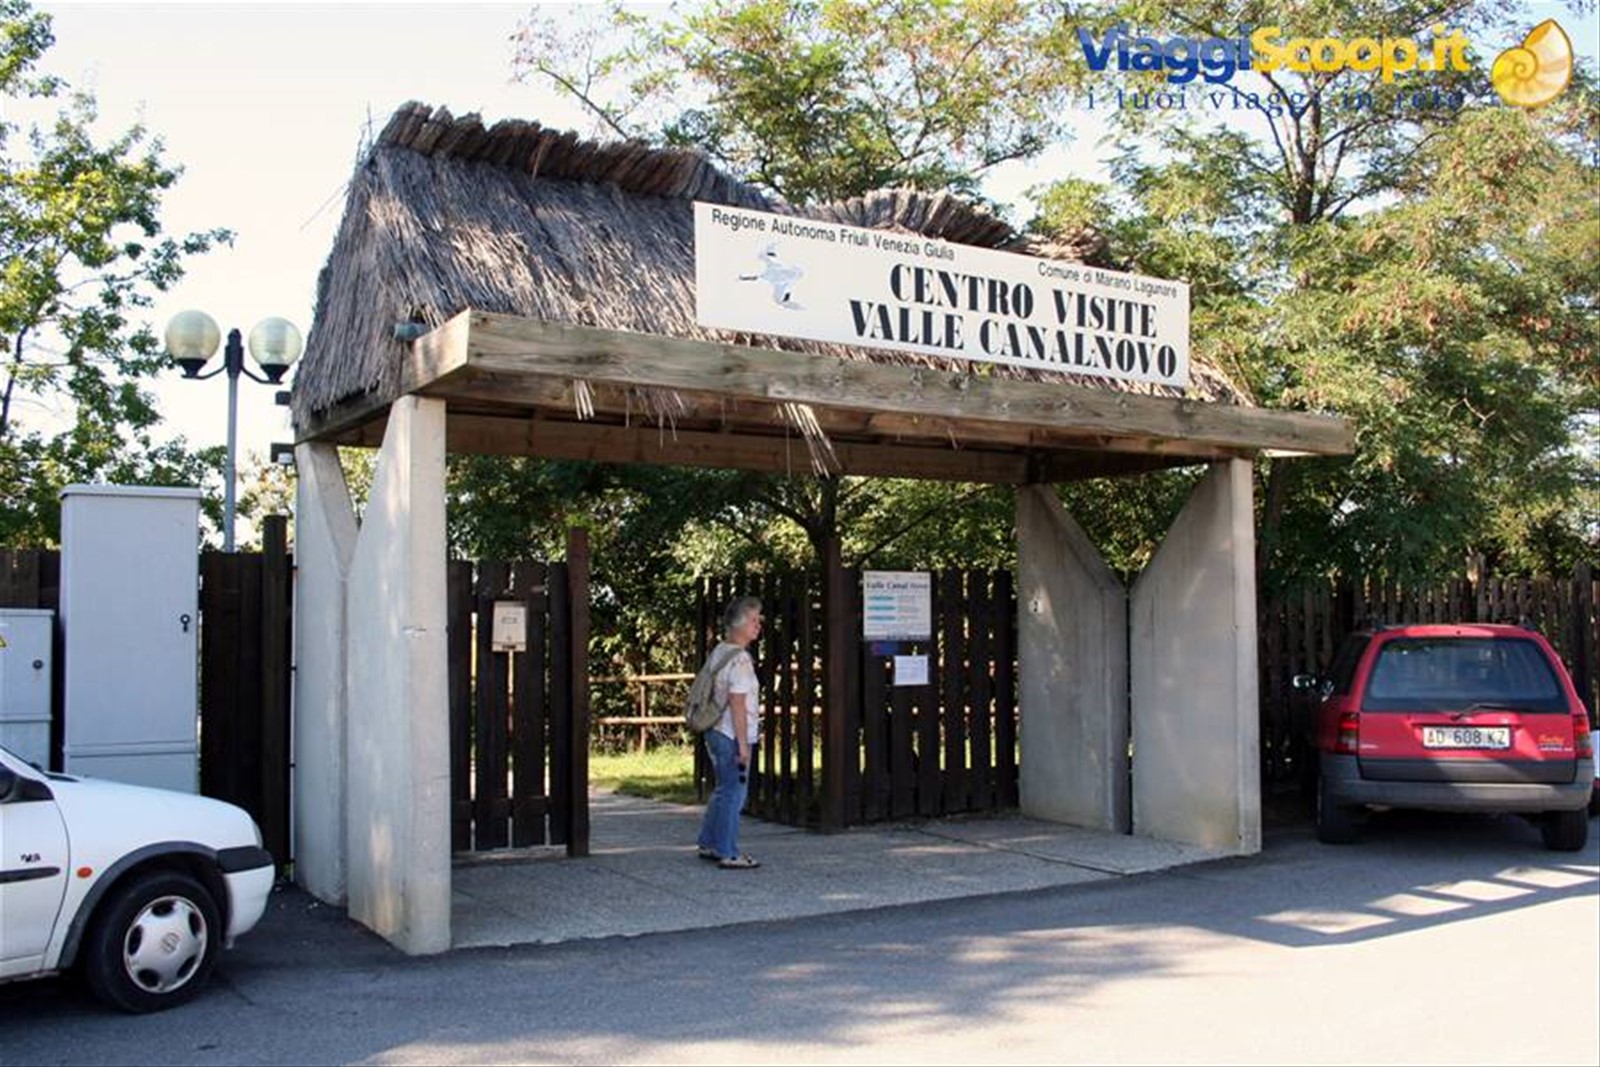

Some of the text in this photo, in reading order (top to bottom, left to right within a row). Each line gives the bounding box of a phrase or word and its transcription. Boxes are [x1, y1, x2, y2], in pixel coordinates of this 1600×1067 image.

[712, 208, 955, 261] Regione Autonoma Friuli Venezia Giulia
[890, 263, 1158, 339] CENTRO VISITE
[1038, 261, 1178, 299] Comune di Marano Lagunare
[850, 299, 1177, 378] VALLE CANALNOVO
[1453, 729, 1482, 745] 608
[1487, 730, 1506, 746] KZ
